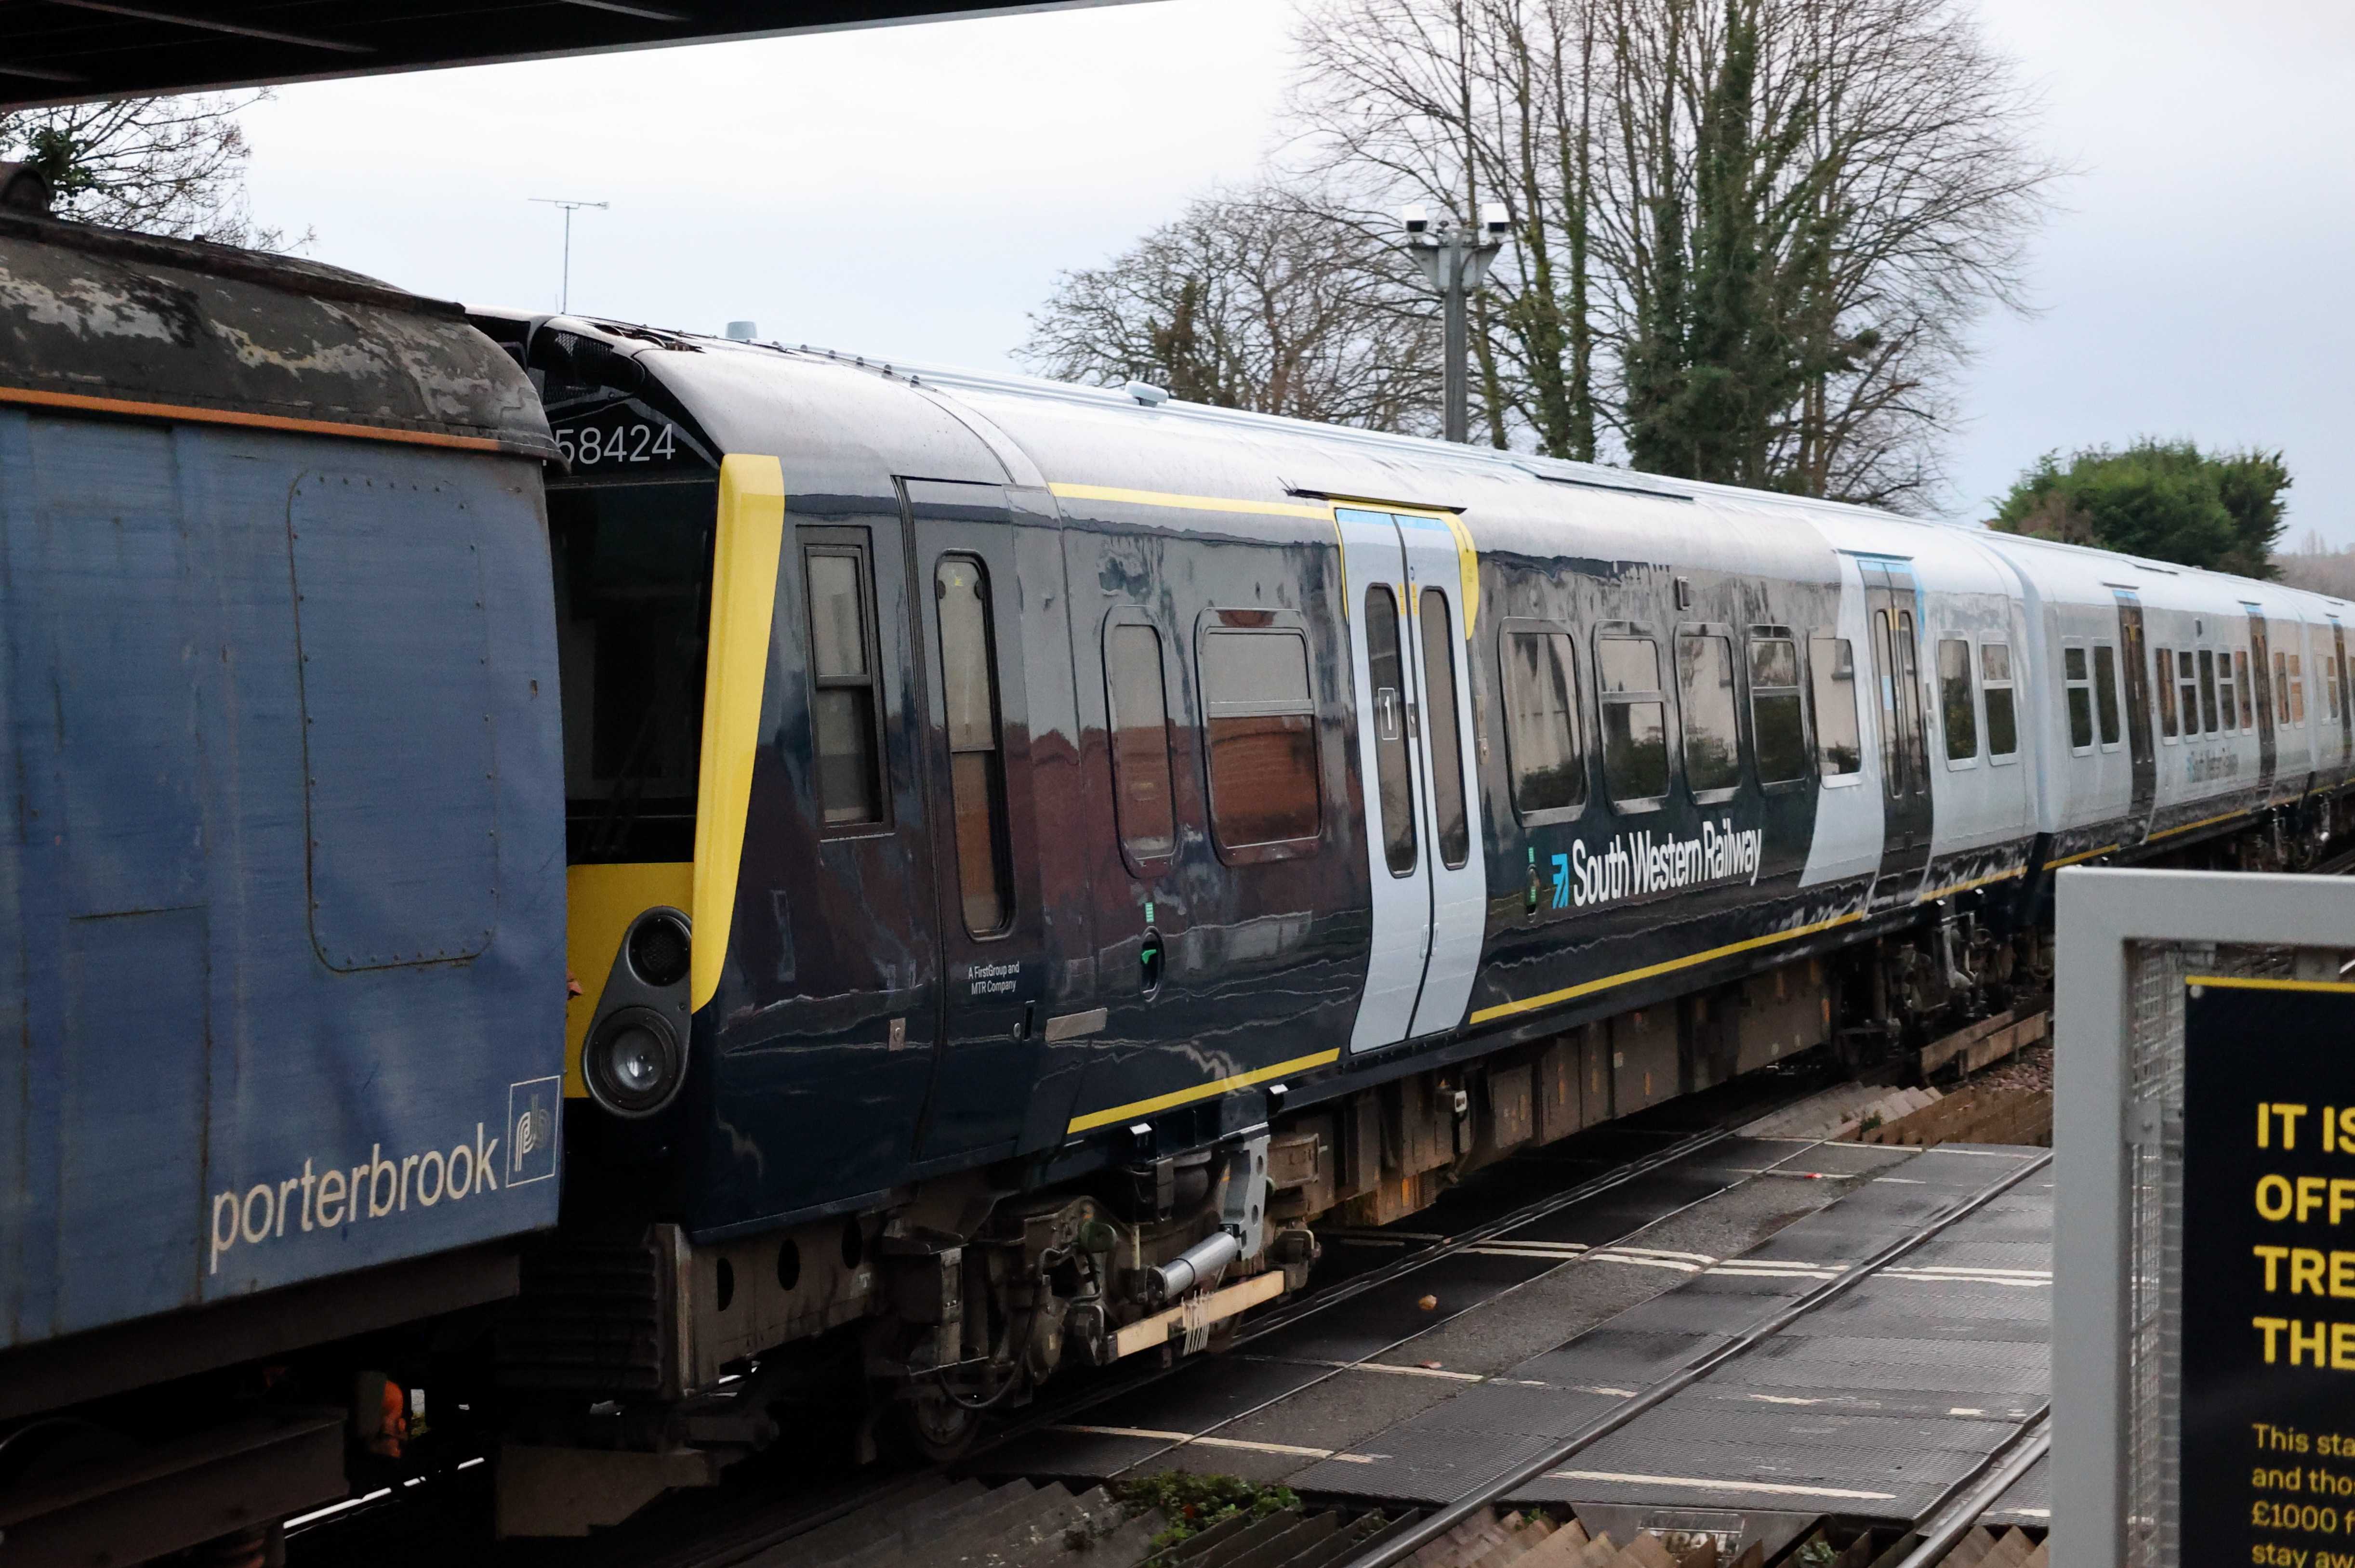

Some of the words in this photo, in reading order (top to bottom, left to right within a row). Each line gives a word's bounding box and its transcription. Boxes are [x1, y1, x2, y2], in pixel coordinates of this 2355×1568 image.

[542, 423, 675, 466] 58424
[1572, 834, 1629, 907] South
[1629, 830, 1702, 895] Western
[1703, 818, 1762, 887] Railway
[968, 967, 974, 980] A
[974, 964, 1007, 978] FirstGroup
[1008, 961, 1020, 975] and
[971, 981, 987, 995] MTR
[987, 980, 1017, 994] Company
[2257, 1103, 2307, 1150] IT
[210, 1122, 499, 1275] porterbrook
[2252, 1423, 2309, 1453] This
[2252, 1467, 2301, 1490] and
[2309, 1469, 2355, 1496] tho
[2252, 1500, 2337, 1533] £1000
